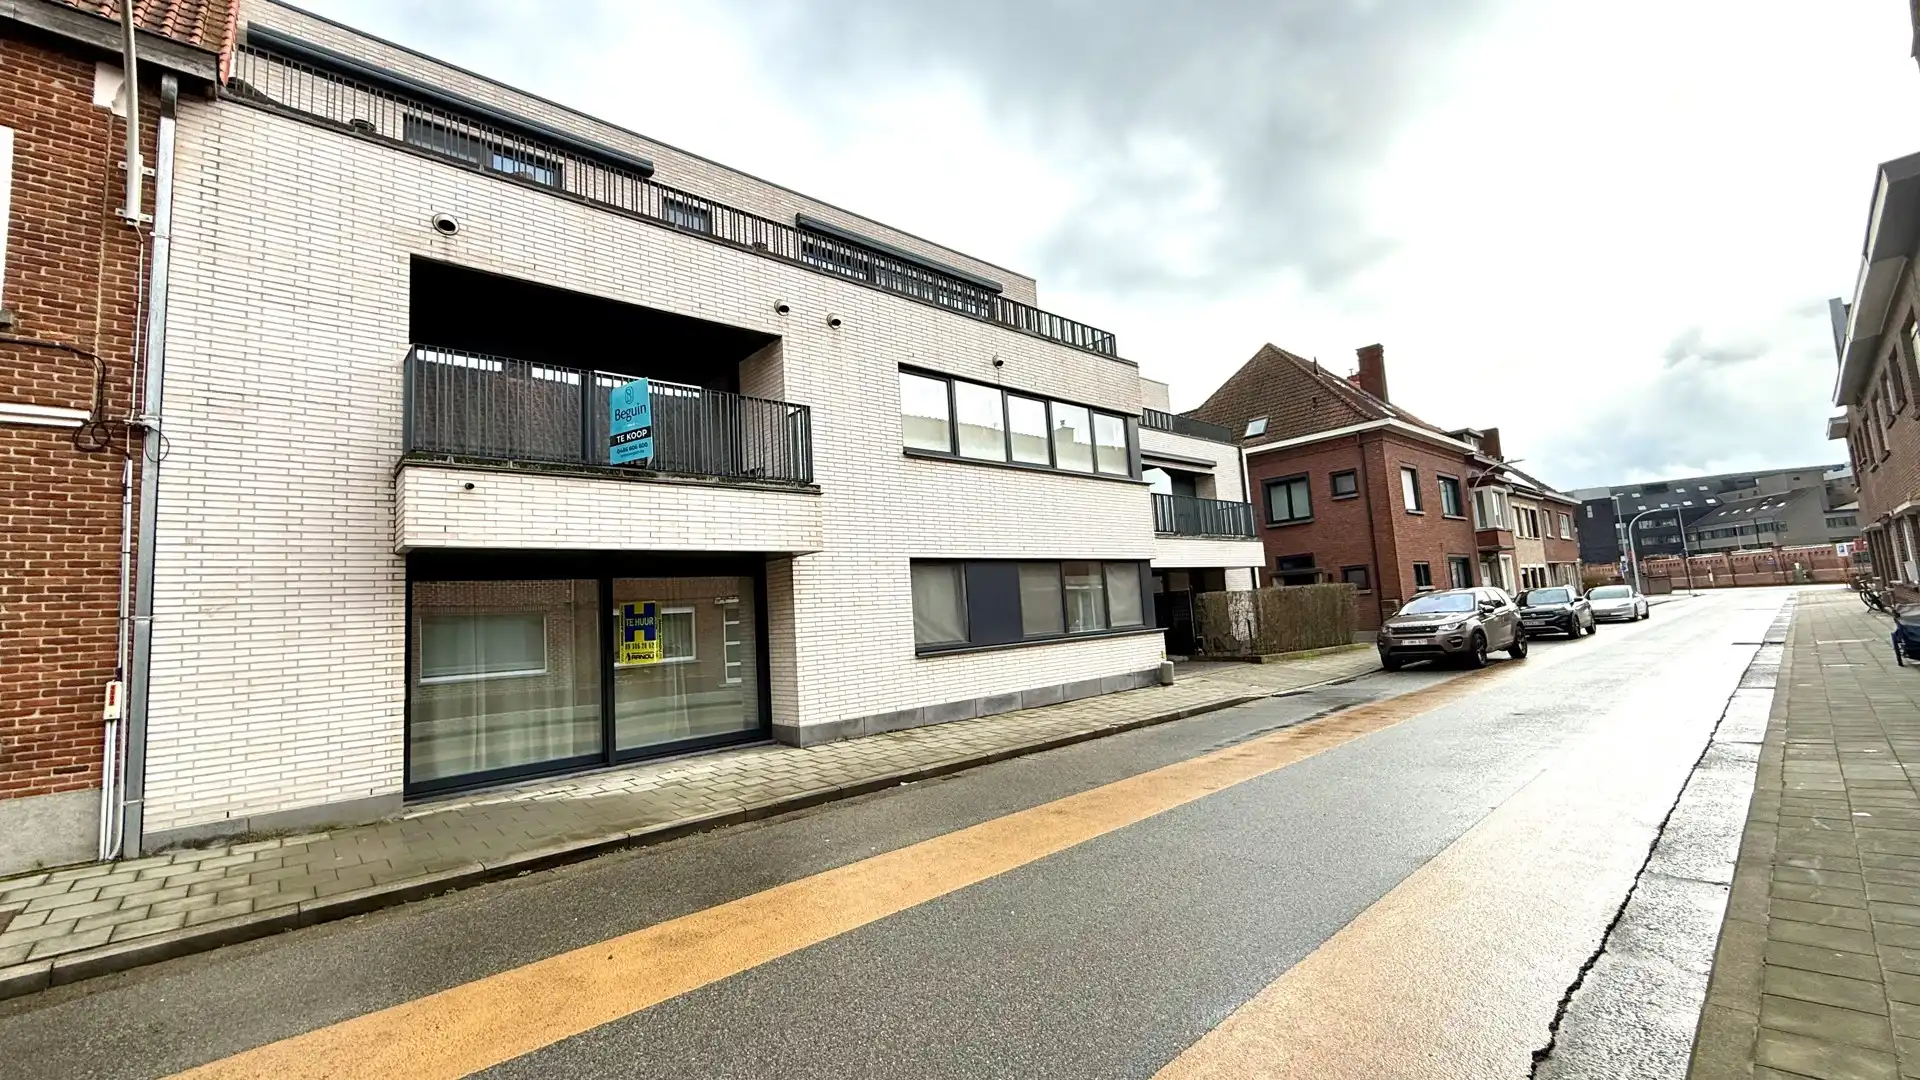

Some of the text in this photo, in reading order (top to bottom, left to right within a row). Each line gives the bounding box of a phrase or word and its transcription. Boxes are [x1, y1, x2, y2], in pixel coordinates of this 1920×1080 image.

[614, 403, 647, 422] Beguin
[616, 429, 648, 444] TE KOOP
[626, 617, 654, 627] TE HUUR
